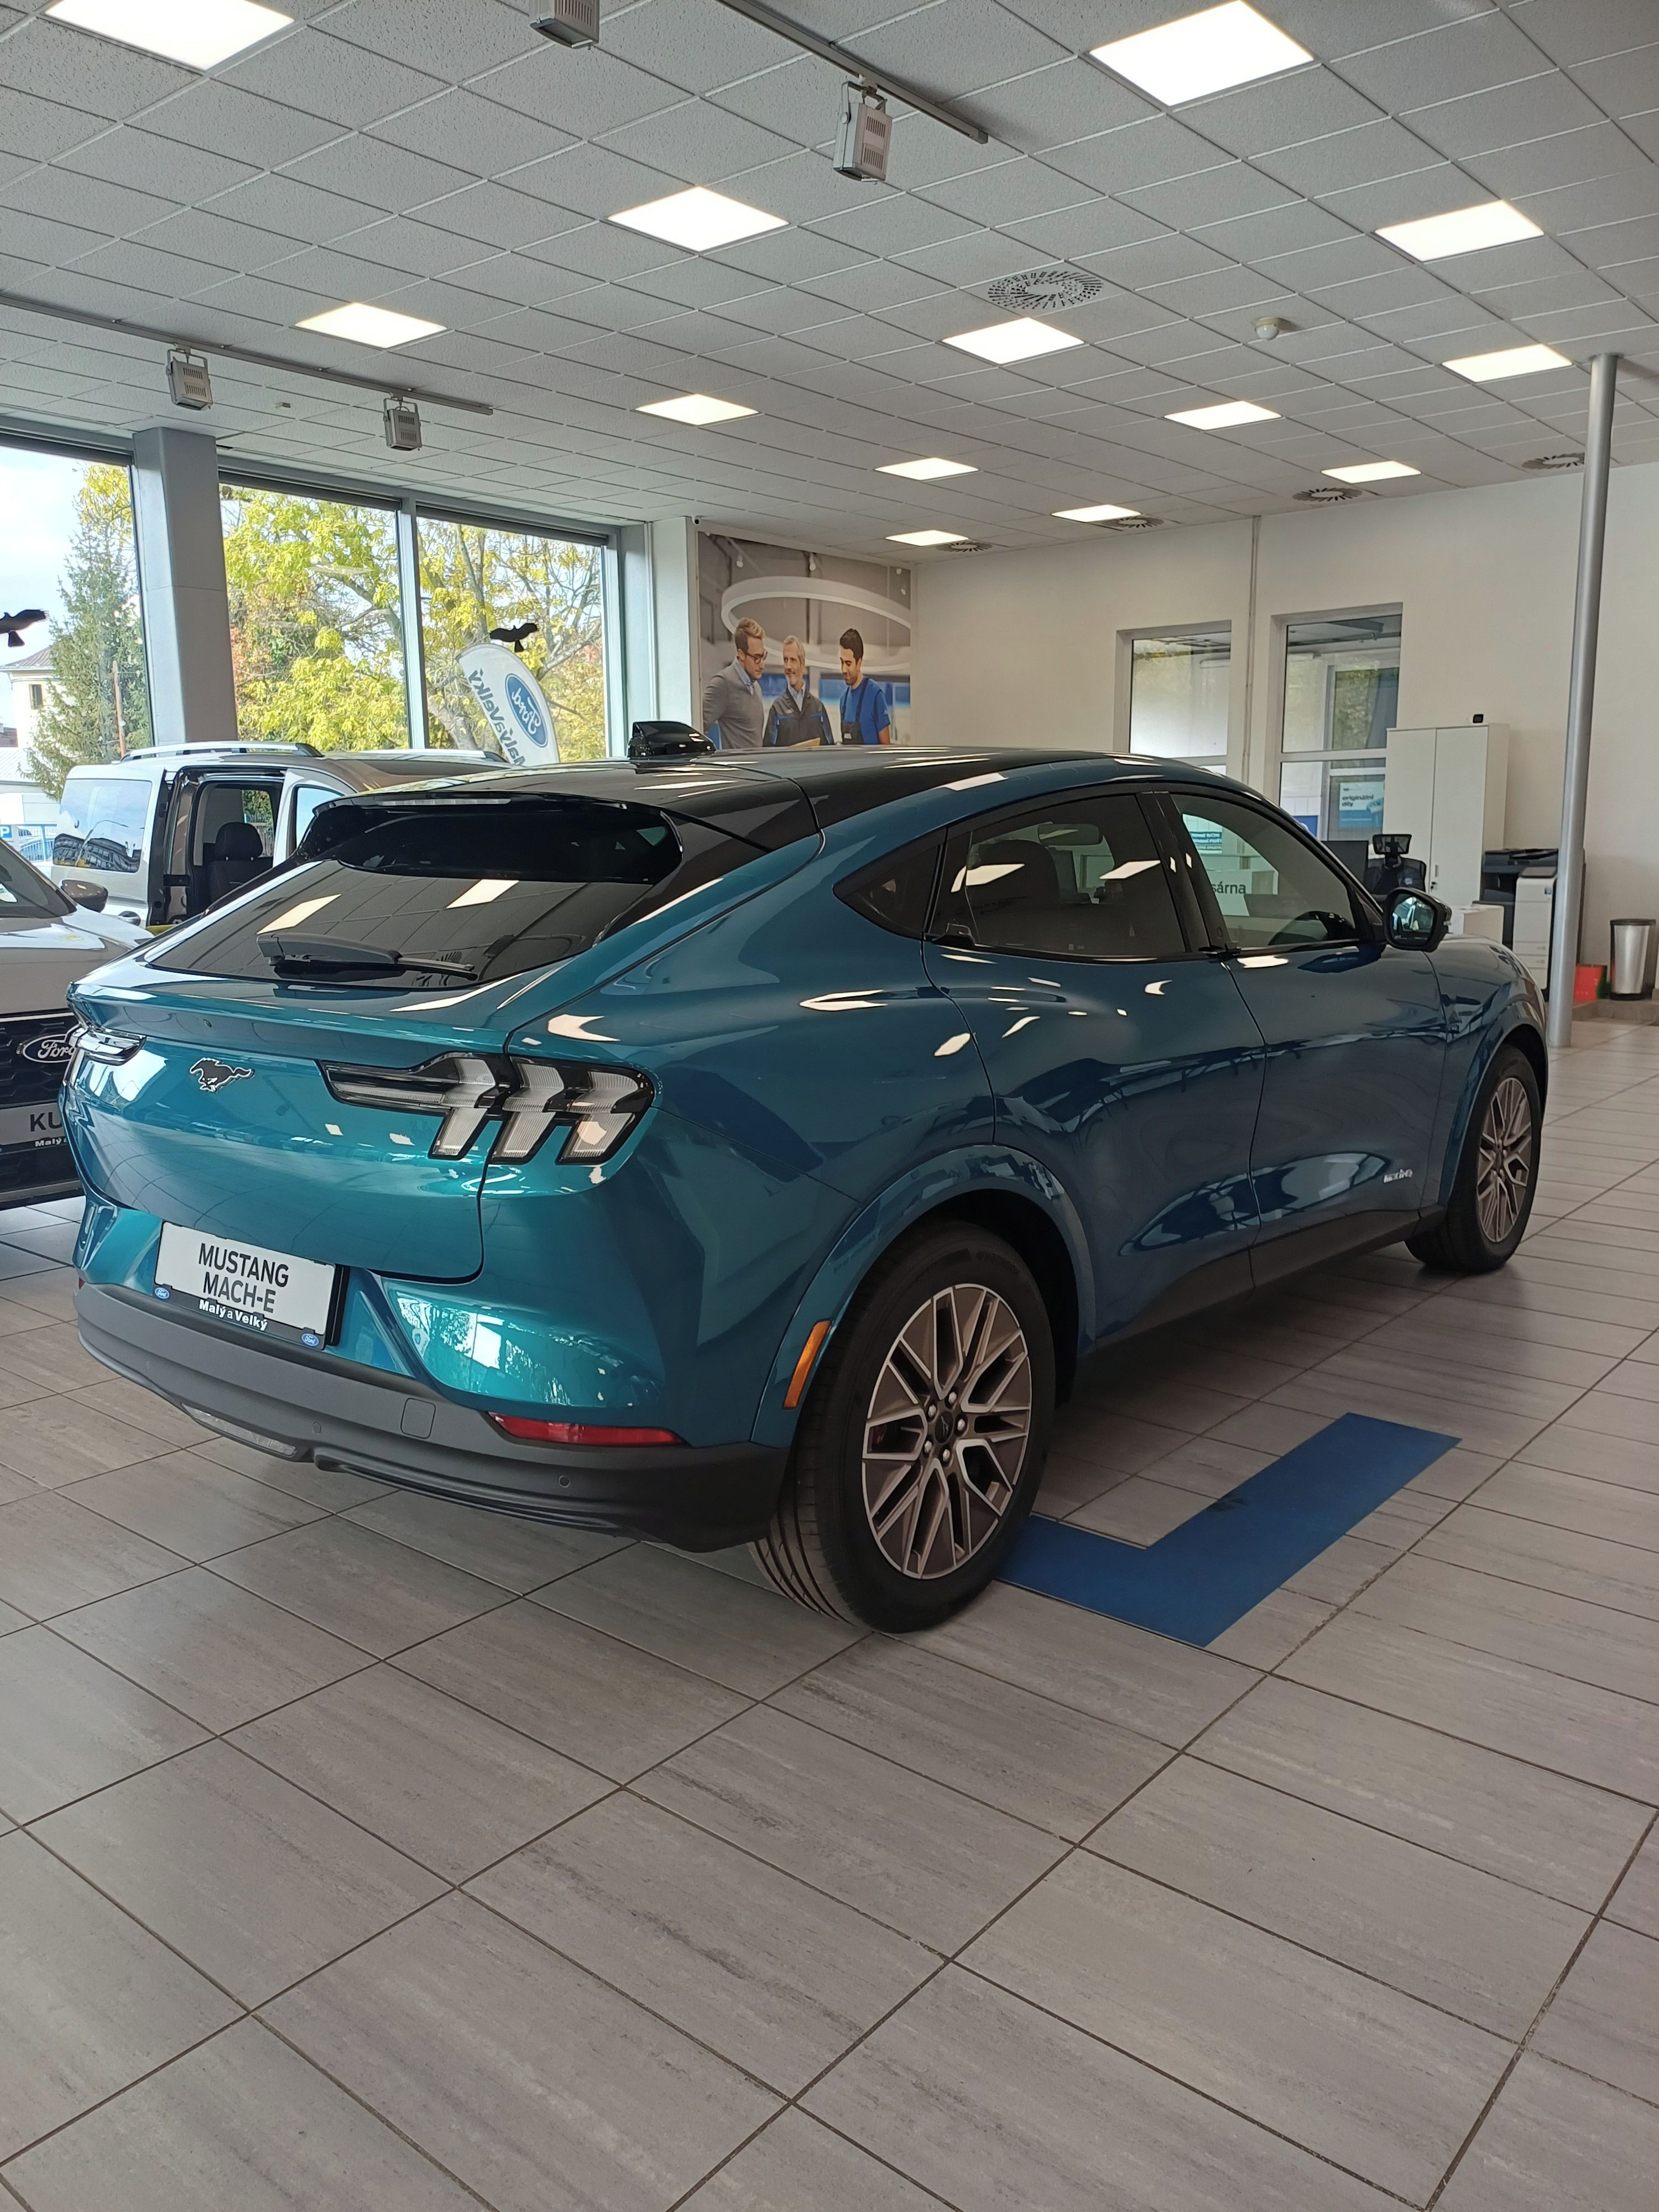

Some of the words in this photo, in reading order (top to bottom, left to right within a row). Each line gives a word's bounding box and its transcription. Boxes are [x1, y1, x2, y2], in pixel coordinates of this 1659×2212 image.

[0, 827, 9, 837] P
[35, 1138, 62, 1147] Malý
[199, 1243, 289, 1287] MUSTANG
[202, 1271, 276, 1313] MACH-E
[199, 1299, 226, 1318] Malý
[226, 1310, 233, 1319] a
[234, 1308, 268, 1331] Velký
